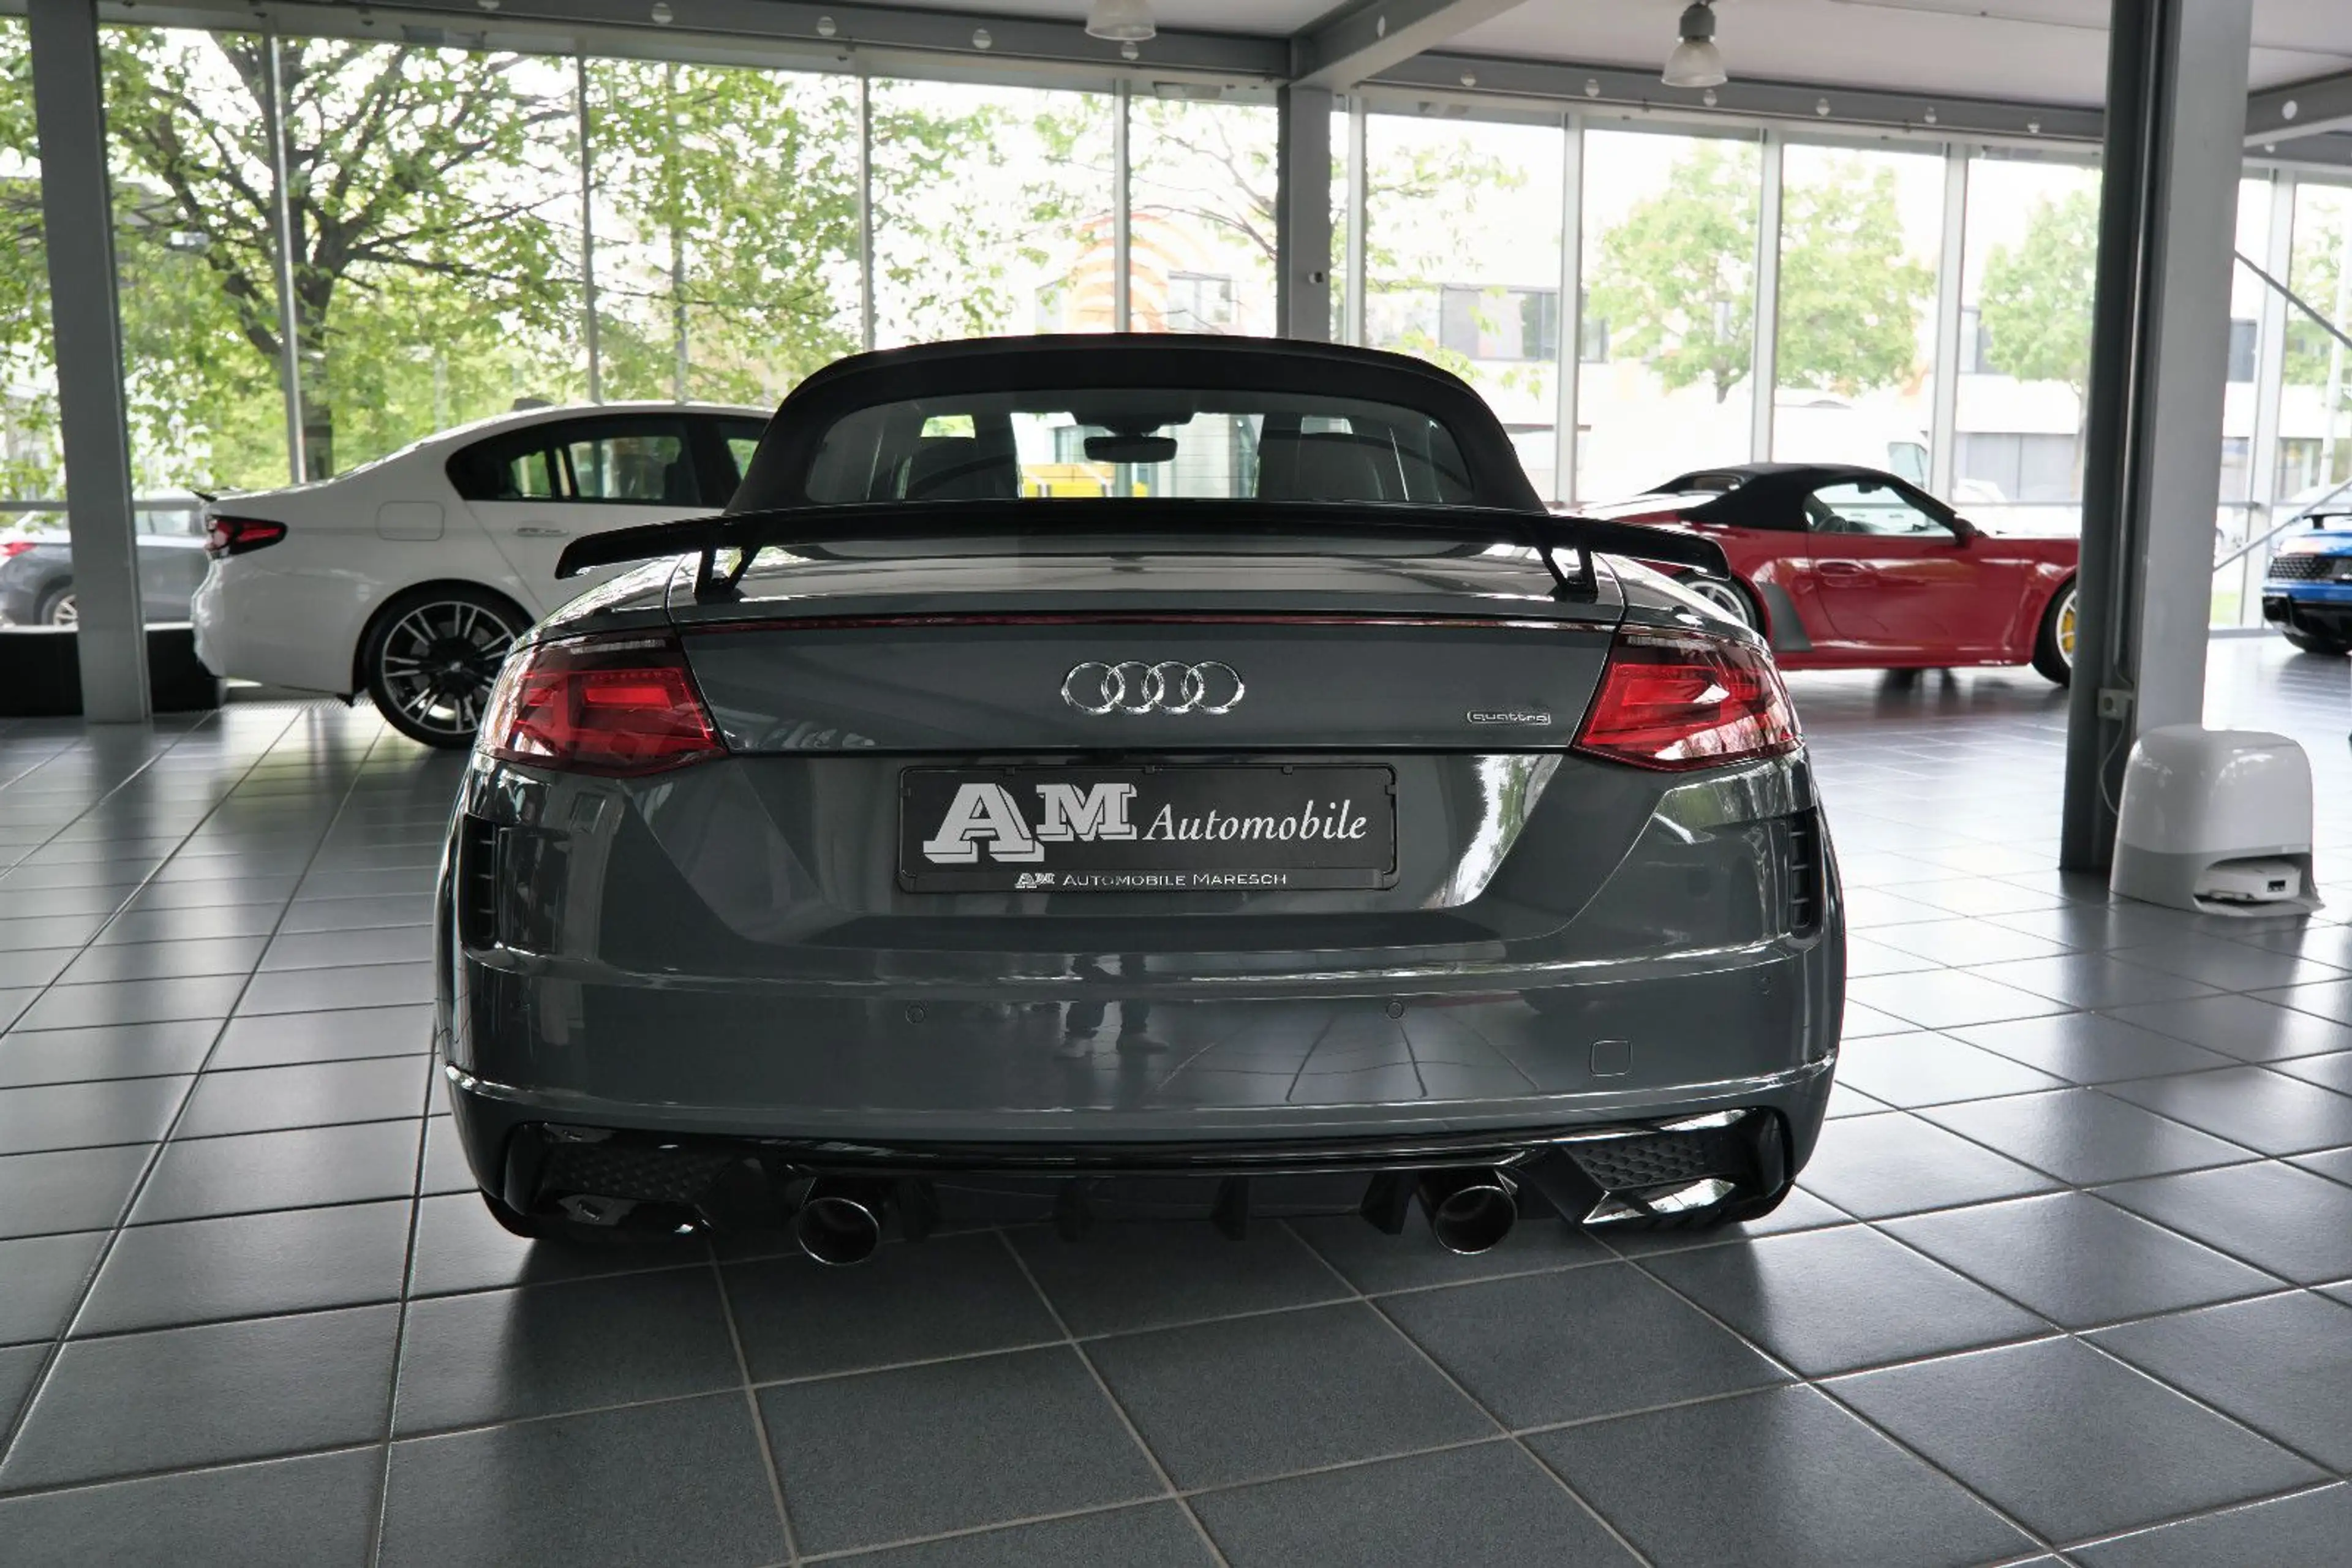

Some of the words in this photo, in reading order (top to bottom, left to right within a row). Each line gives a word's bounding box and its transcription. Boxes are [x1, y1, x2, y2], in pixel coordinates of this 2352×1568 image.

[1471, 712, 1549, 723] quattro
[923, 783, 1137, 864] AM
[1142, 799, 1367, 840] Automobile
[1014, 872, 1055, 888] AM
[1063, 874, 1186, 886] AUTOMOBILE
[1193, 873, 1287, 885] MARESCH
